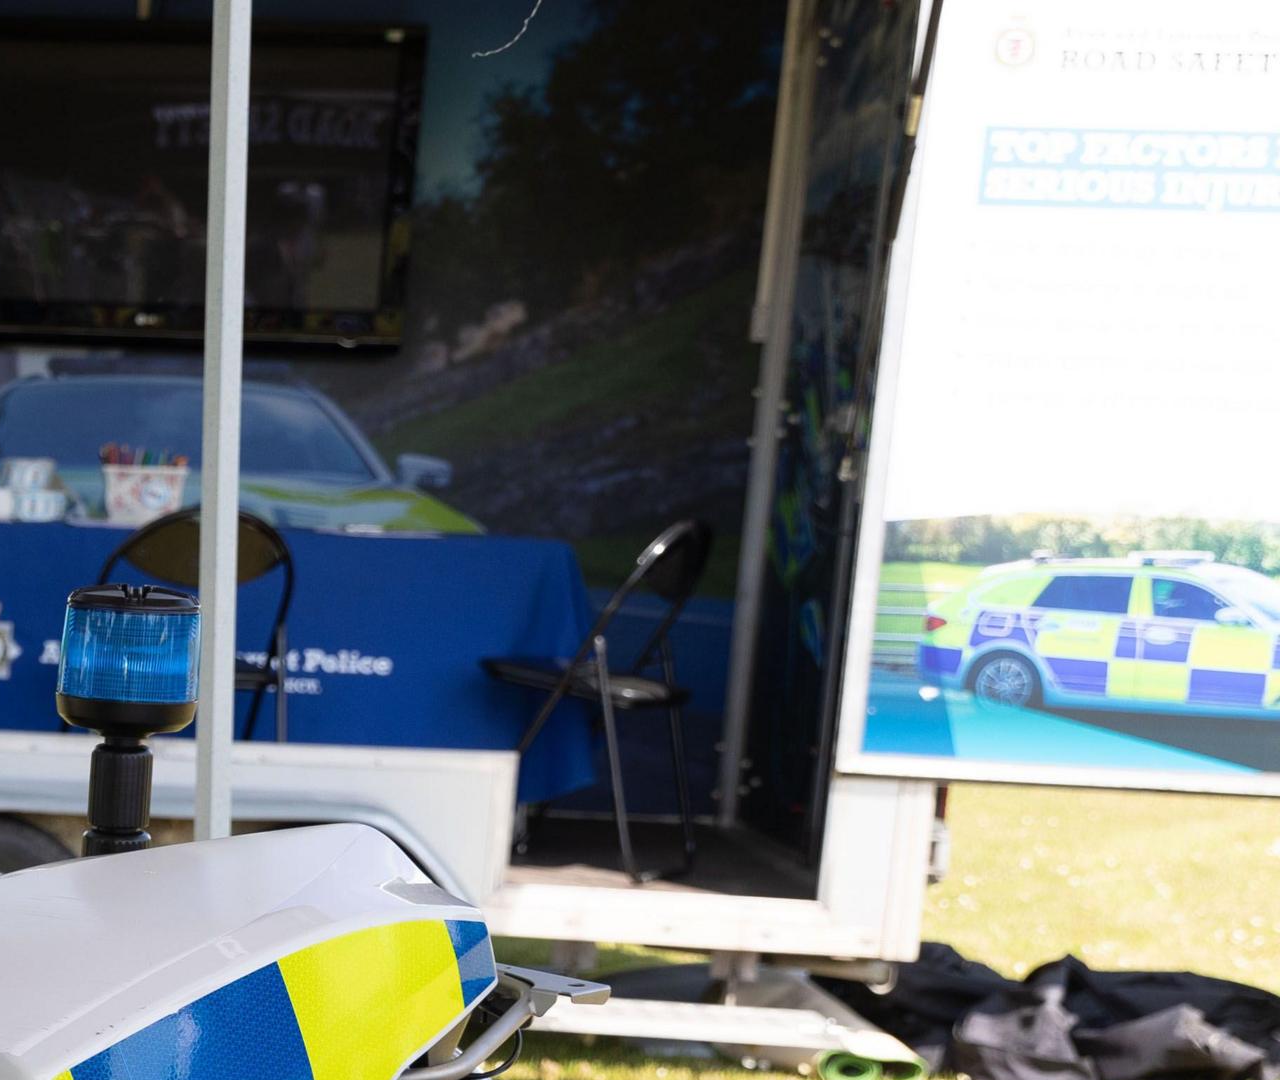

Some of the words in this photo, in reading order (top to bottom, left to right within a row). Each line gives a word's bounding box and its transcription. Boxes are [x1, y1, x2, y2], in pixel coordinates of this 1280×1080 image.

[1059, 50, 1156, 71] ROAD
[990, 130, 1078, 163] TOP
[1080, 132, 1271, 168] FACTORS
[984, 167, 1156, 203] SERIOUS
[302, 648, 394, 676] Police
